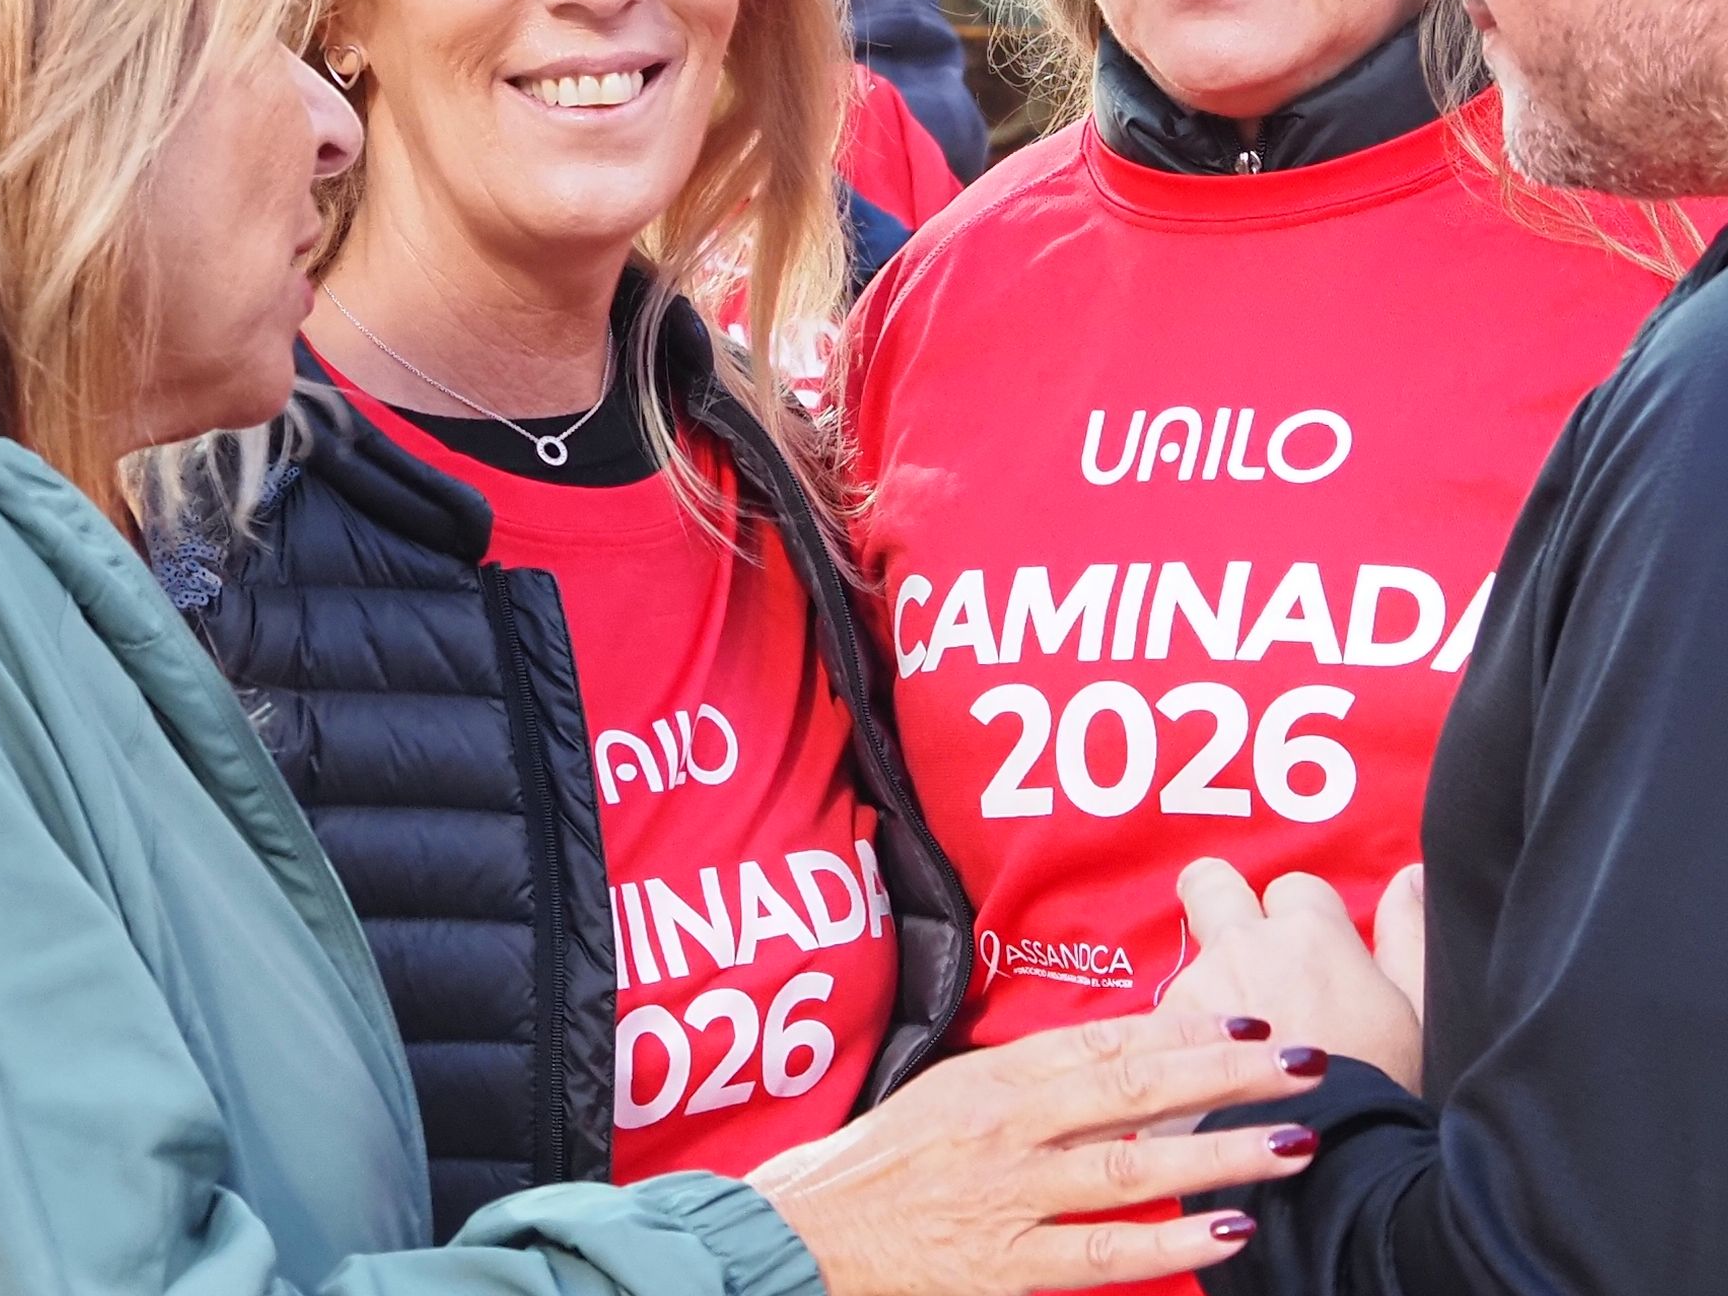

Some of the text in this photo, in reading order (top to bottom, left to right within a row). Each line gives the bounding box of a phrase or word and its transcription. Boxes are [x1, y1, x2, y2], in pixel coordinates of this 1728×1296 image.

[1080, 406, 1353, 485] UAILO
[594, 703, 739, 805] AILO
[969, 680, 1359, 824] 2026
[609, 837, 893, 991] INADA
[614, 970, 835, 1129] 026
